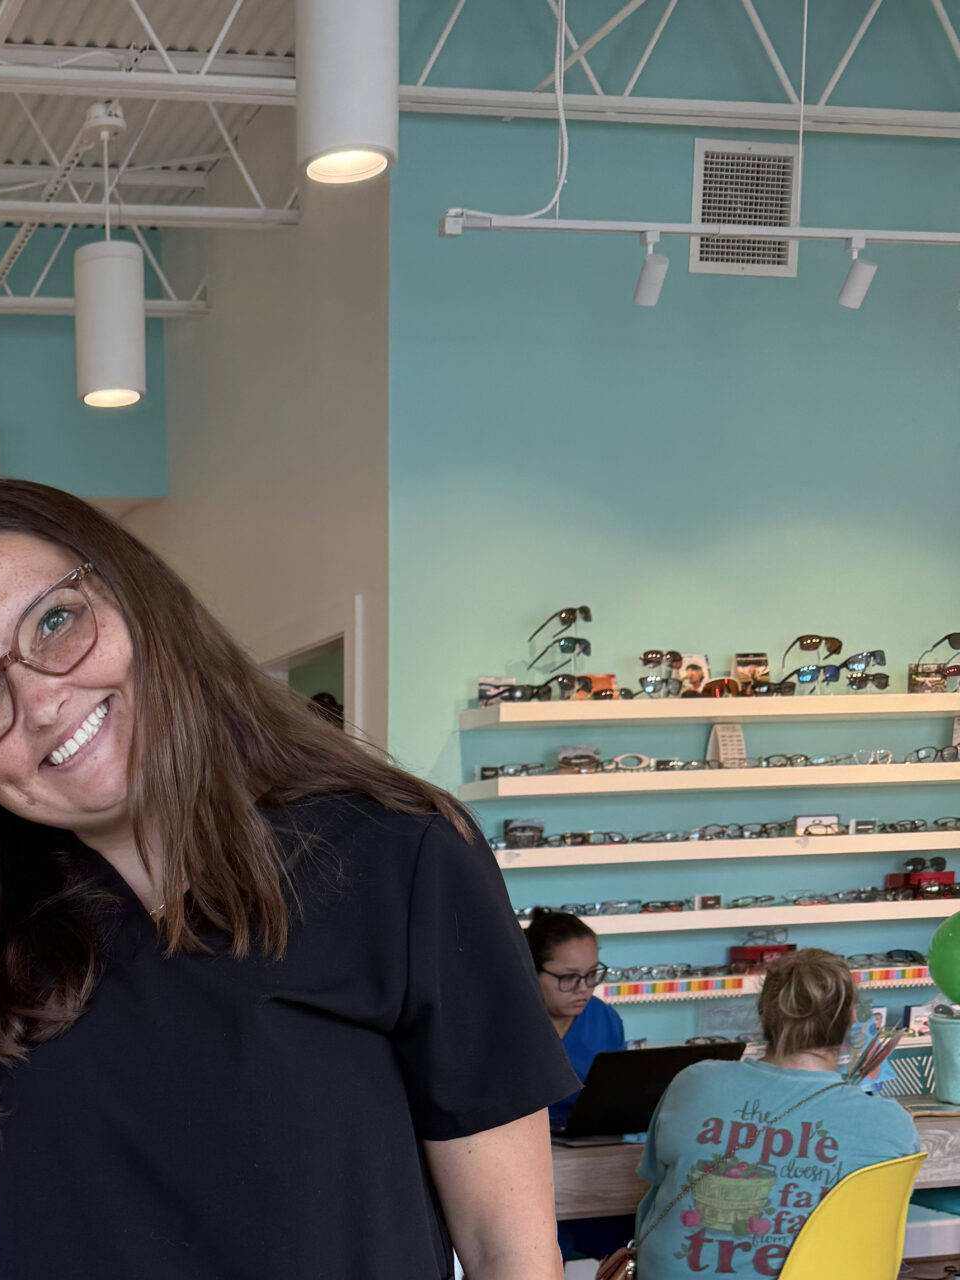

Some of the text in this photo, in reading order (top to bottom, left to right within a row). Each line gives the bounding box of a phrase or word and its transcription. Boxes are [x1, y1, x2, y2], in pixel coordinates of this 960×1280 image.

[734, 1099, 772, 1123] the
[696, 1117, 839, 1165] apple
[780, 1159, 843, 1186] doesn't
[778, 1183, 830, 1208] fal
[772, 1211, 806, 1234] fa
[684, 1227, 789, 1276] tre
